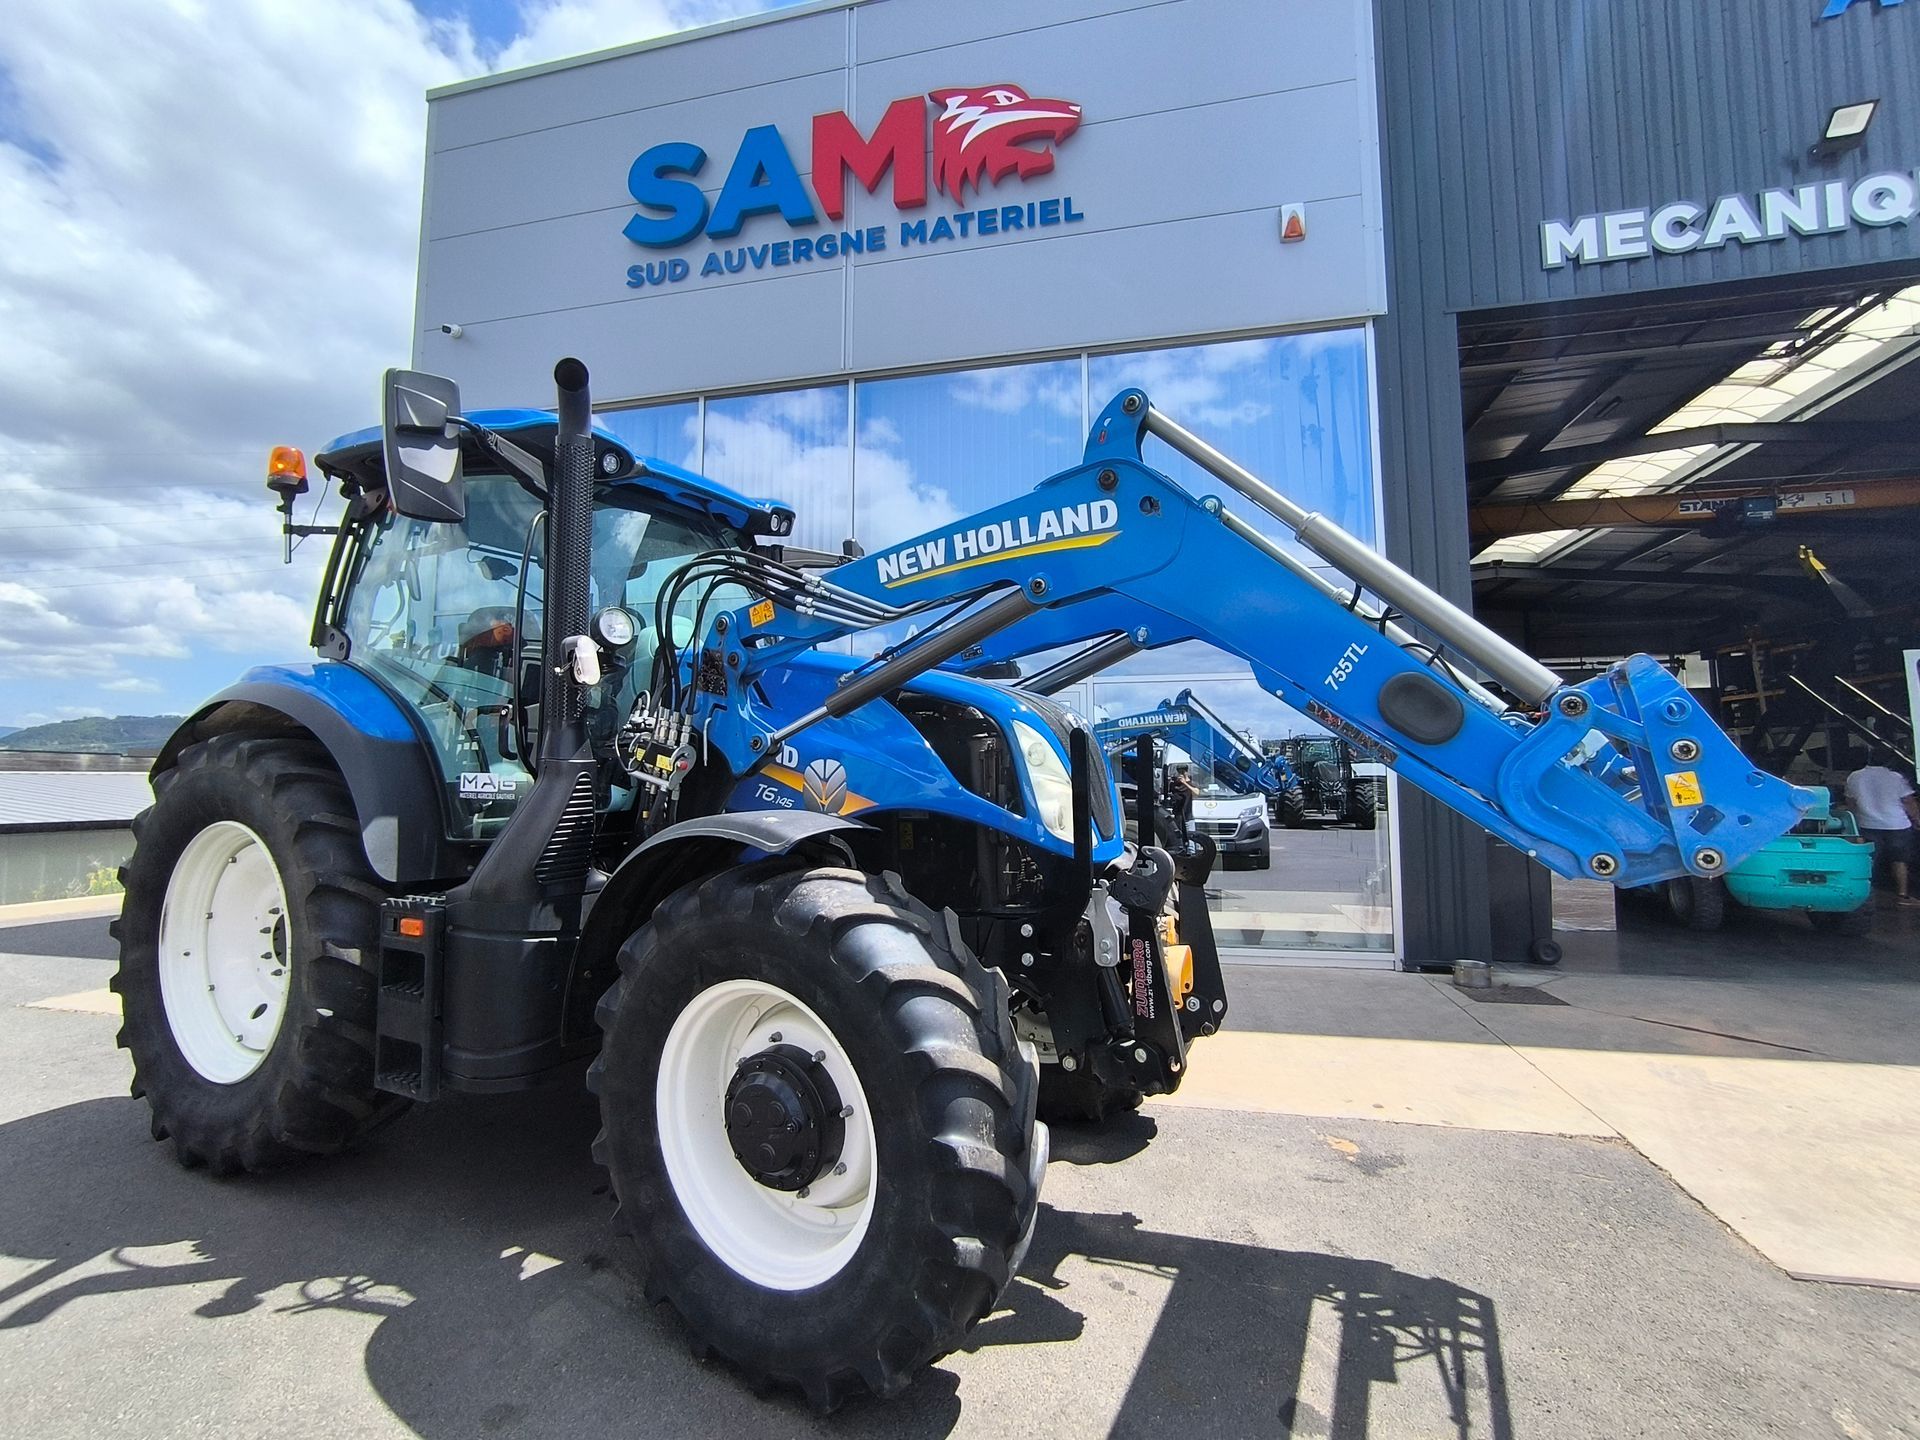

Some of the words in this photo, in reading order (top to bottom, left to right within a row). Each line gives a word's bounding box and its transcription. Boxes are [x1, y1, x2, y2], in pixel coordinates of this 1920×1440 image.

[622, 96, 927, 248] SAM
[626, 257, 689, 288] SUD
[701, 225, 886, 276] AUVERGNE
[900, 196, 1084, 247] MATERIEL
[1541, 166, 1920, 269] MECANIQ
[877, 537, 946, 584] NEW
[953, 499, 1119, 561] HOLLAND
[1324, 642, 1369, 691] 755TL
[462, 773, 517, 790] MAG
[755, 783, 795, 808] T6.145
[1131, 938, 1149, 1018] ZUIDBERG
